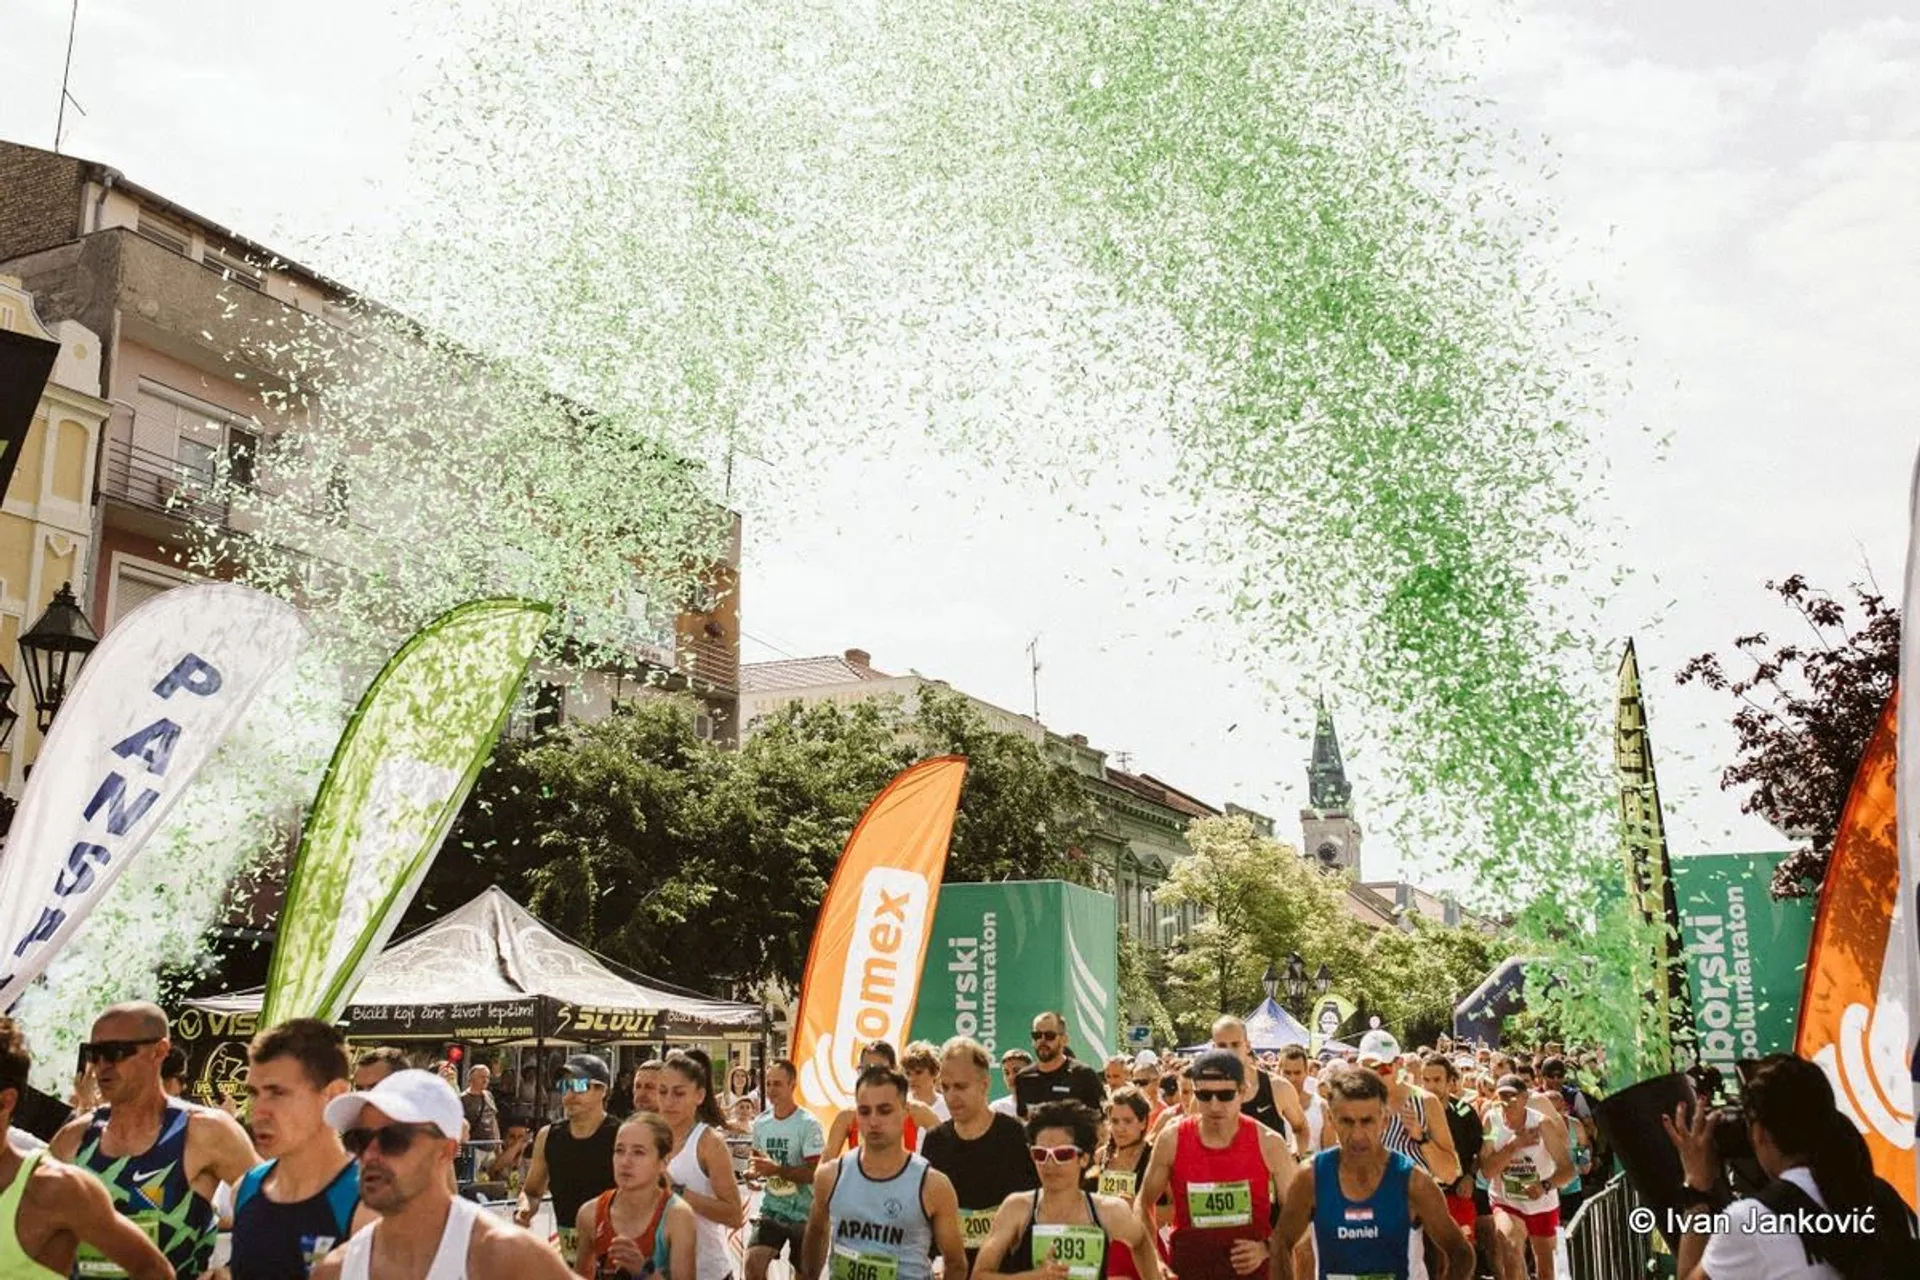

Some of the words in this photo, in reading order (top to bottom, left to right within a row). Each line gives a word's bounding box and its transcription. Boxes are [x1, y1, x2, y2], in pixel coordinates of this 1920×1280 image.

[454, 1025, 534, 1038] venerabike.com
[1205, 1191, 1235, 1212] 450
[837, 1218, 905, 1246] APATIN
[1337, 1225, 1379, 1240] Daniel
[1052, 1236, 1086, 1261] 393
[847, 1259, 879, 1280] 366
